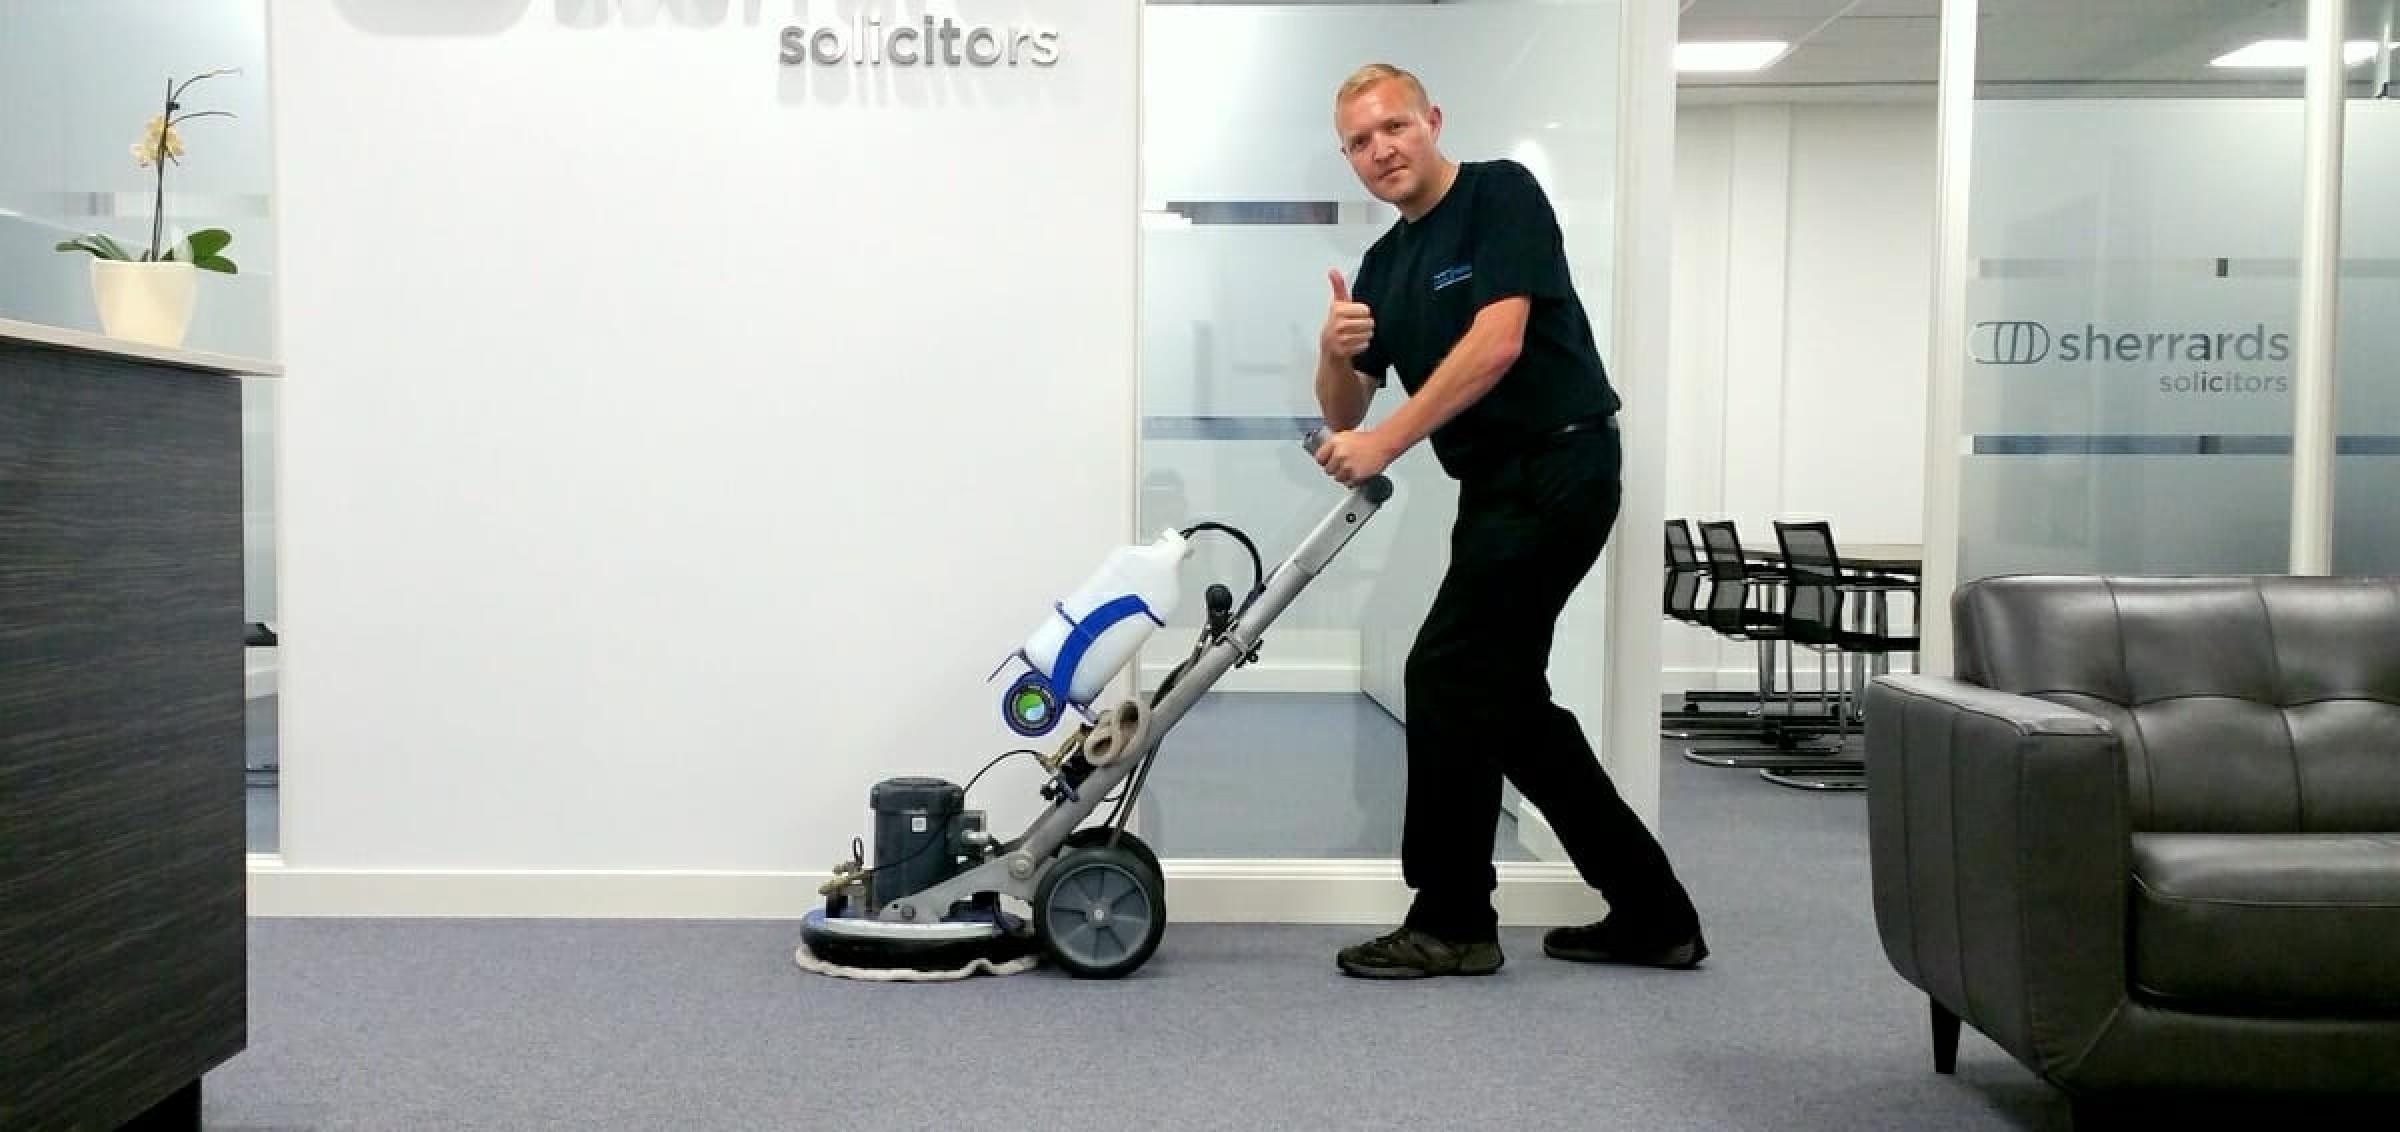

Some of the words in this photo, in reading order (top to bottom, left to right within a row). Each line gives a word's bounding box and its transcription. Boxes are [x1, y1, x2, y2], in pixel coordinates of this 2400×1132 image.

[779, 15, 1060, 67] solicitors
[2057, 323, 2290, 362] sherrards
[2158, 370, 2290, 394] solicitors
